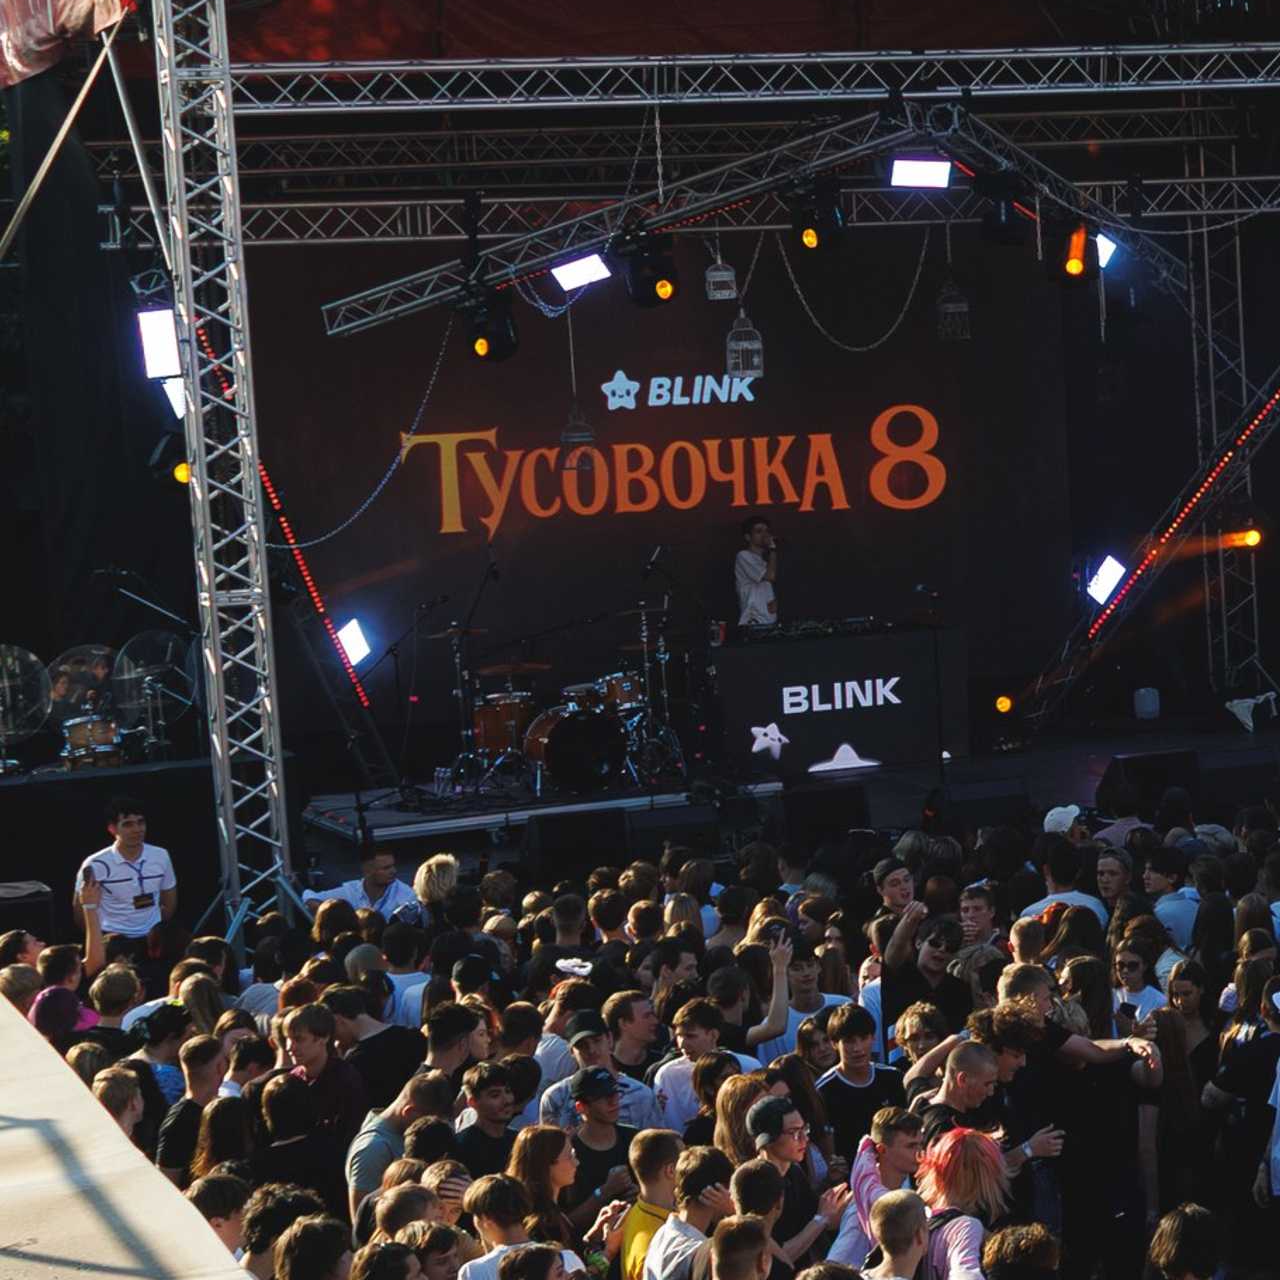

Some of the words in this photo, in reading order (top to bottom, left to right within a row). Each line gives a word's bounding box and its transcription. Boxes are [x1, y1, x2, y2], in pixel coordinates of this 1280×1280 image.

[647, 374, 756, 407] BLINK
[868, 404, 947, 510] 8
[782, 676, 902, 715] BLINK
